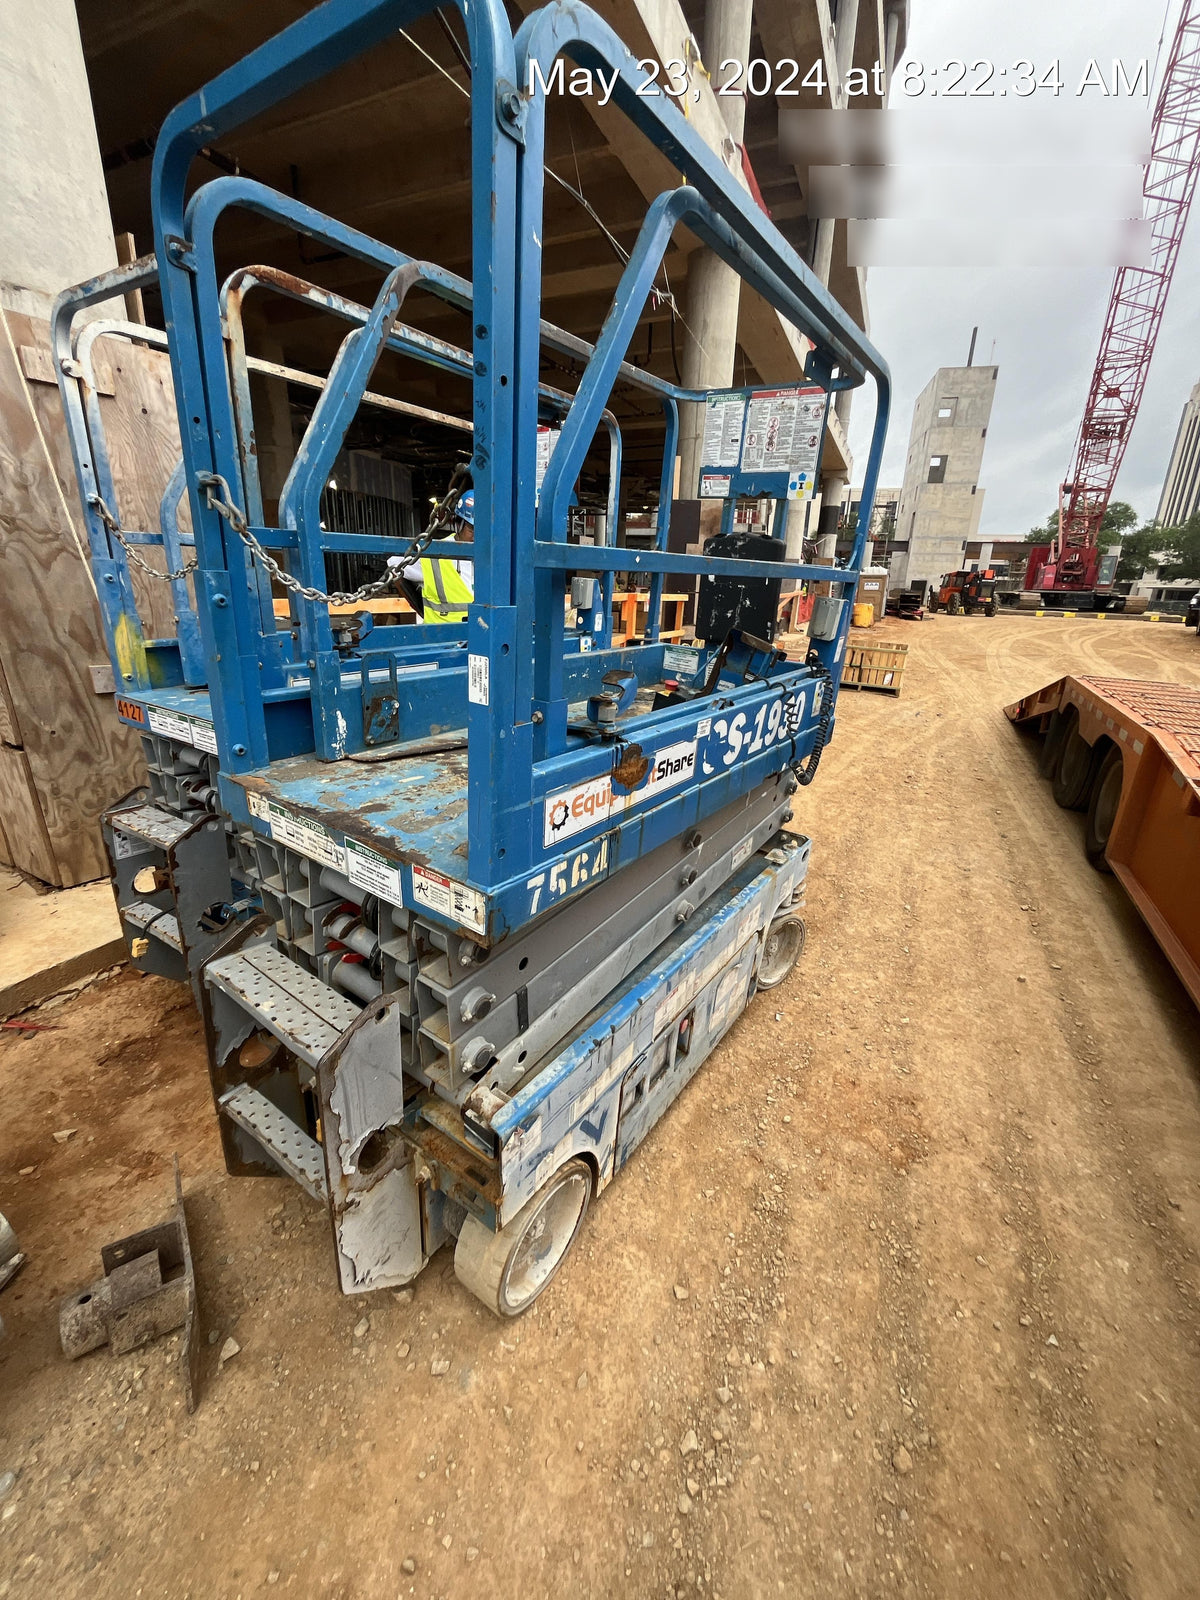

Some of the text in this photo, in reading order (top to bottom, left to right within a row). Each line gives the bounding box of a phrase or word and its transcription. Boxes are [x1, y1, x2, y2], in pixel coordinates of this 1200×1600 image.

[118, 700, 142, 722] 4127
[571, 753, 694, 817] EquiptShare
[284, 810, 326, 836] INSRUCTIONS
[424, 870, 443, 884] DANGER
[527, 840, 608, 917] 7564
